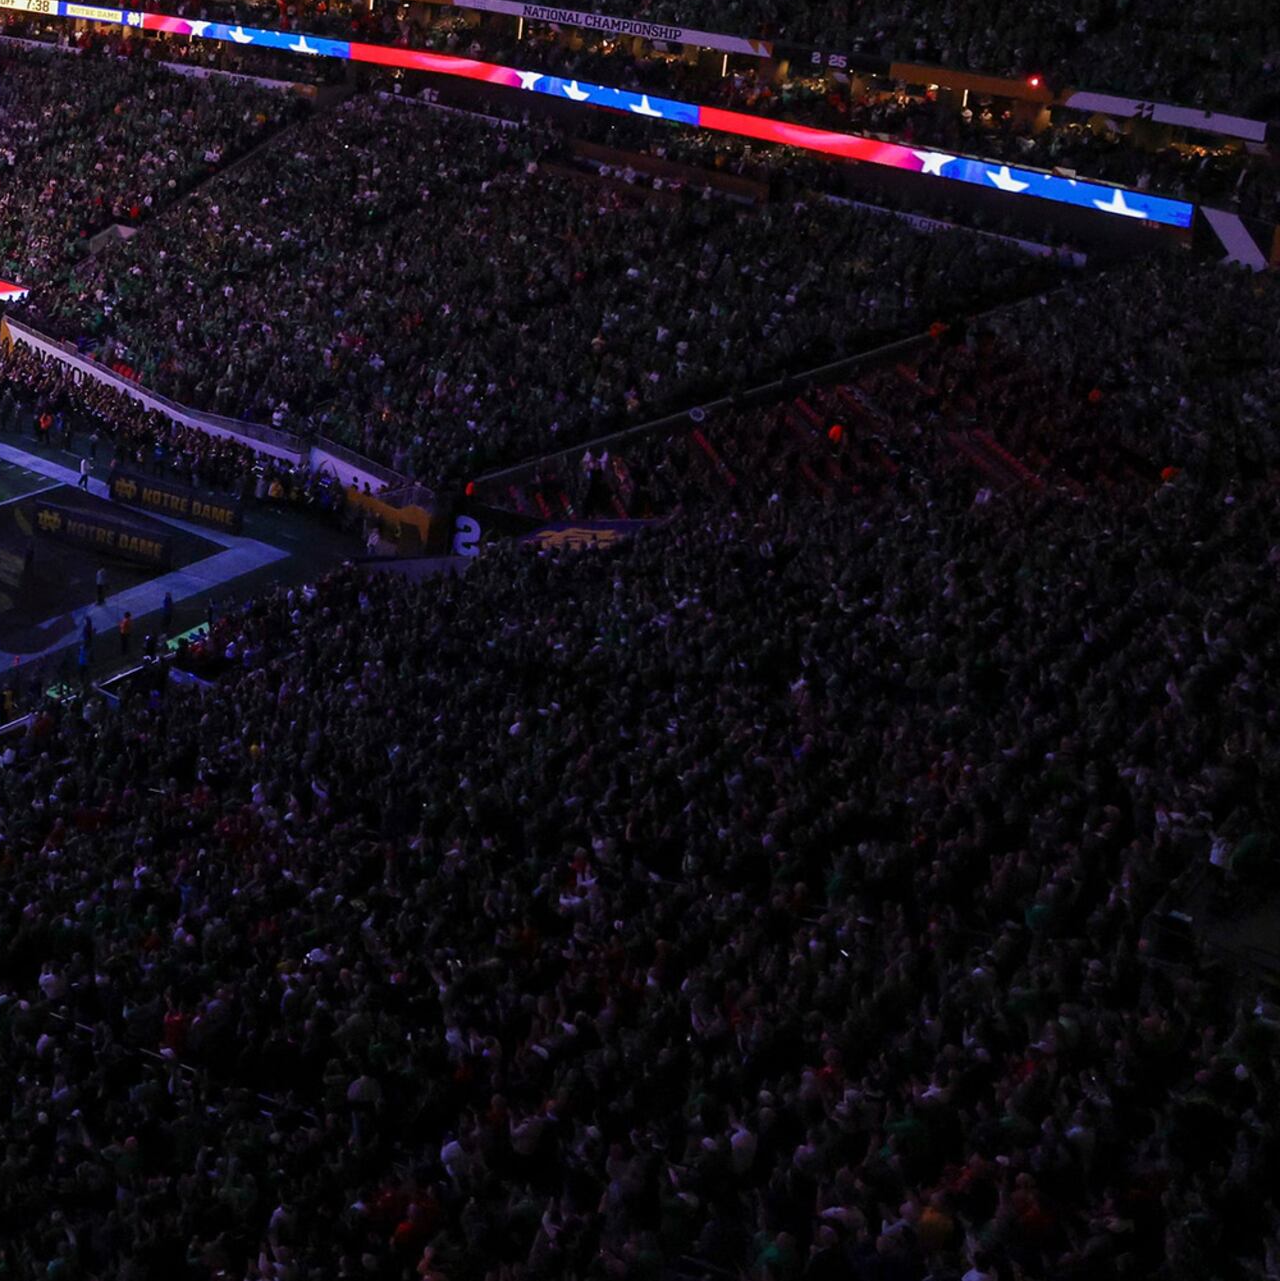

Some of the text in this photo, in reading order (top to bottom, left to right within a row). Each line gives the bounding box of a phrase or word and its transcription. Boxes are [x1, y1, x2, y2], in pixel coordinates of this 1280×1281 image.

[523, 5, 683, 40] NATIONAL CHAMPIONSHIP
[828, 53, 848, 69] 25
[142, 486, 190, 514] NOTRE
[191, 499, 235, 526] DAME
[66, 519, 114, 547] NOTRE
[117, 532, 164, 559] DAME
